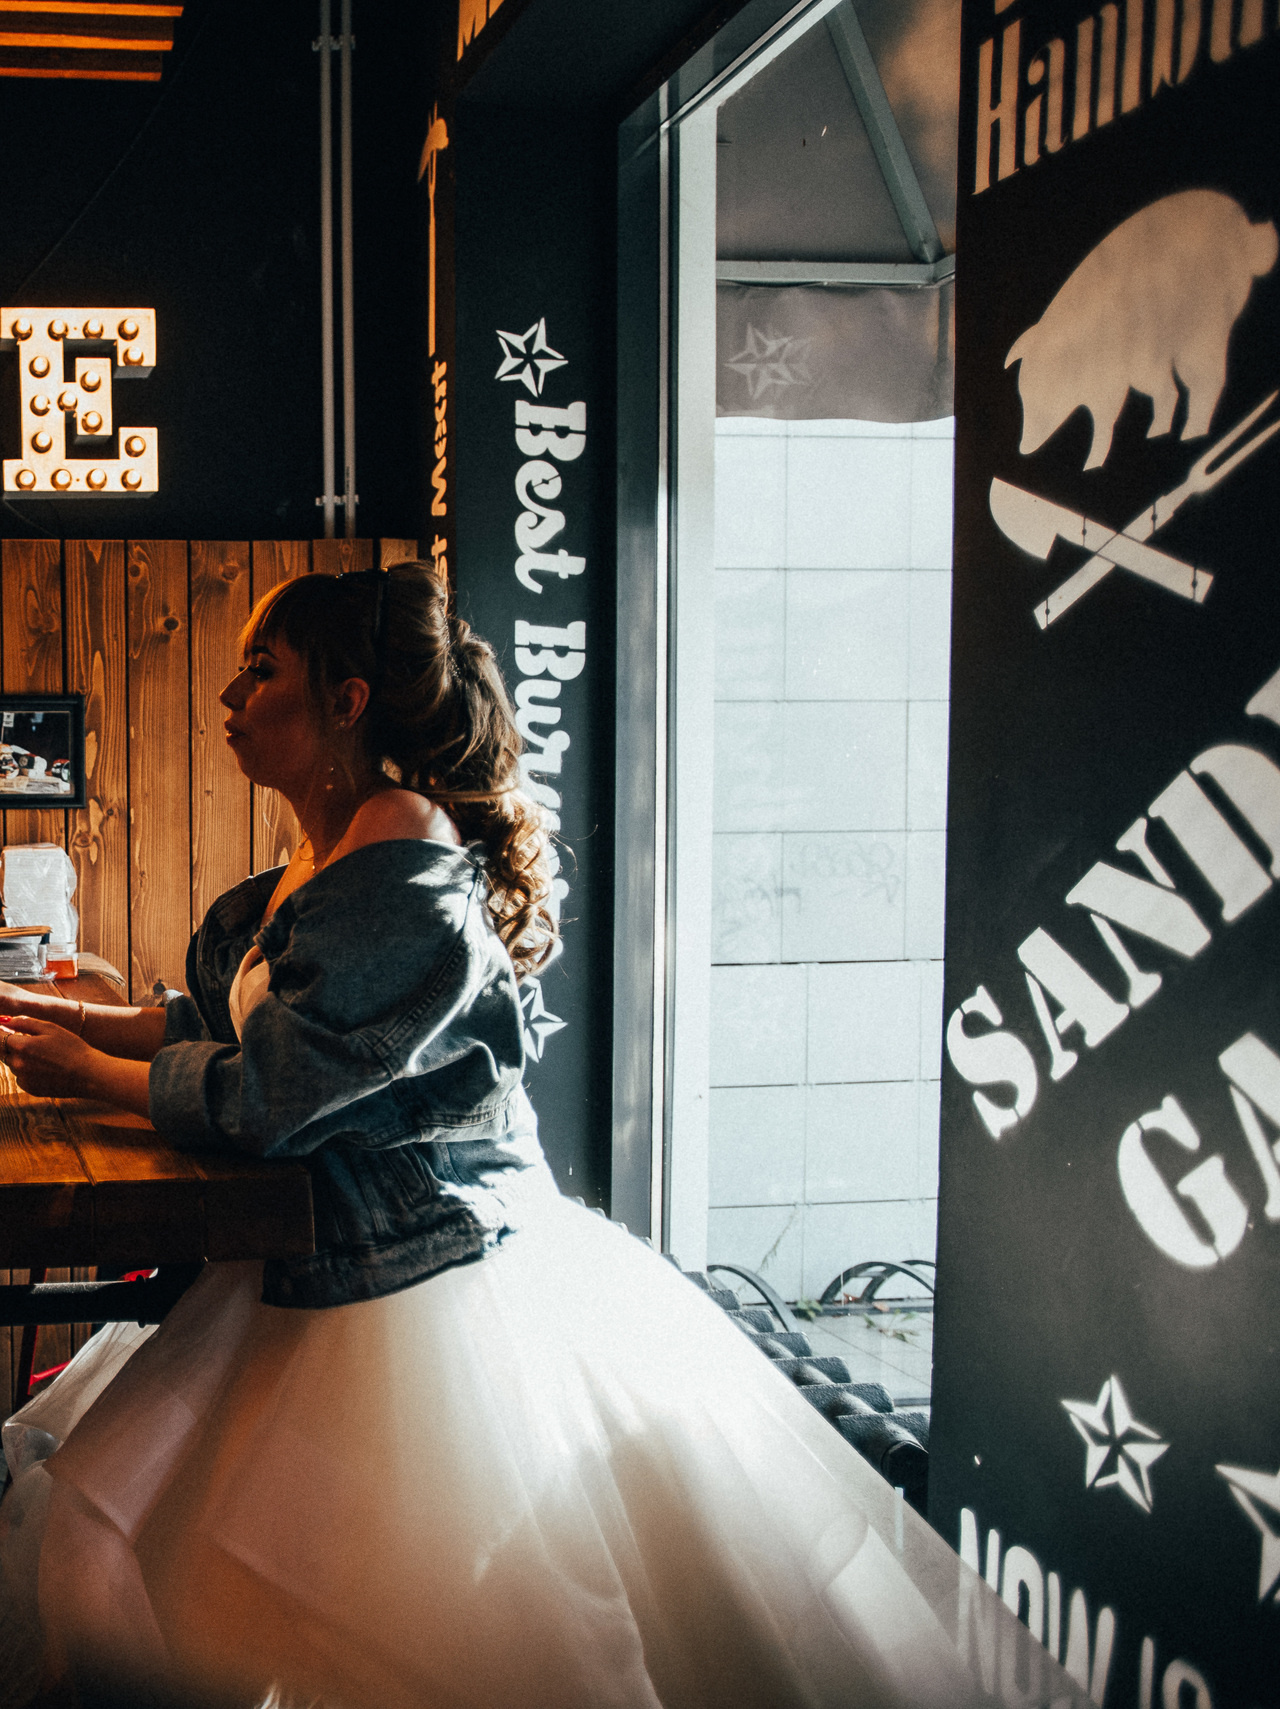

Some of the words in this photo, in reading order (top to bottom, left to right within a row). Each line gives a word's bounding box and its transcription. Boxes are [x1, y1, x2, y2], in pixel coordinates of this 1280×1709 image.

[431, 361, 448, 516] Meat
[515, 401, 587, 595] Best
[945, 668, 1280, 1142] SAND
